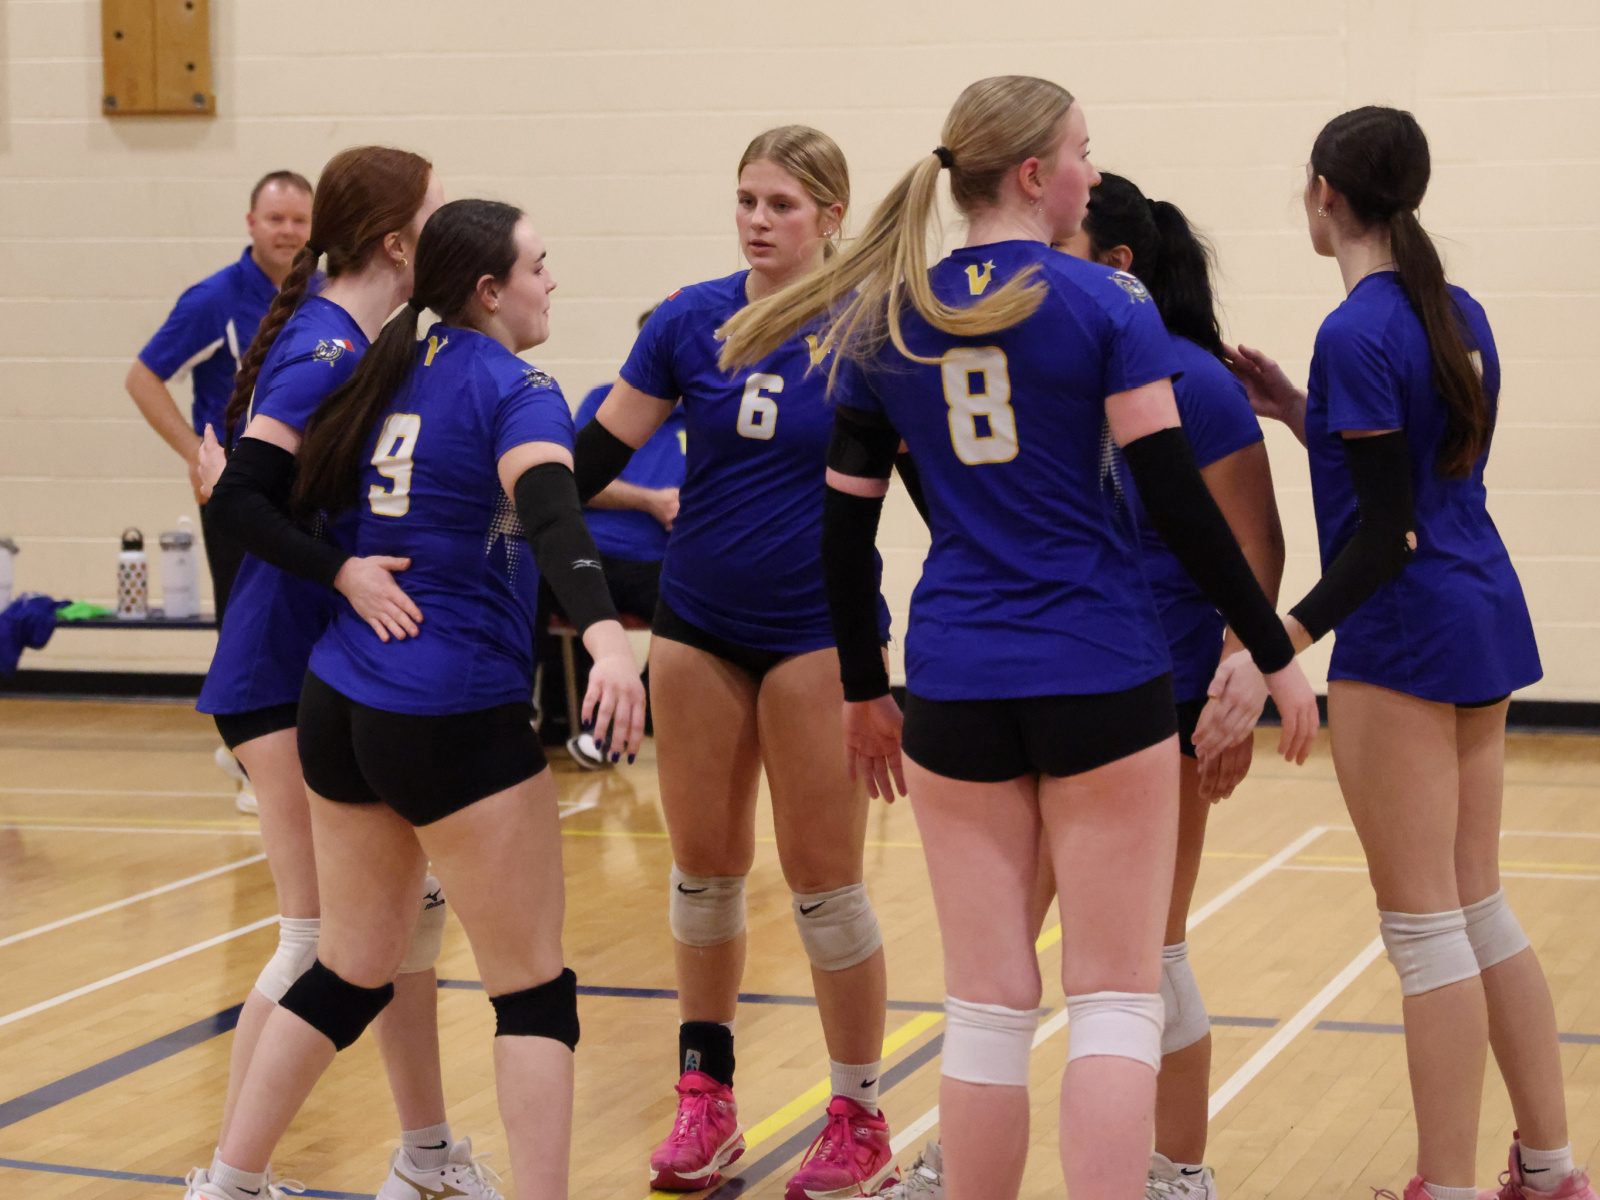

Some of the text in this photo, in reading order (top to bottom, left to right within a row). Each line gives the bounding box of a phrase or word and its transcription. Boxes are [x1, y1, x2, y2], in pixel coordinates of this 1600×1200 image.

[964, 259, 996, 295] V
[737, 372, 784, 440] 6
[941, 345, 1019, 466] 8
[368, 413, 421, 517] 9
